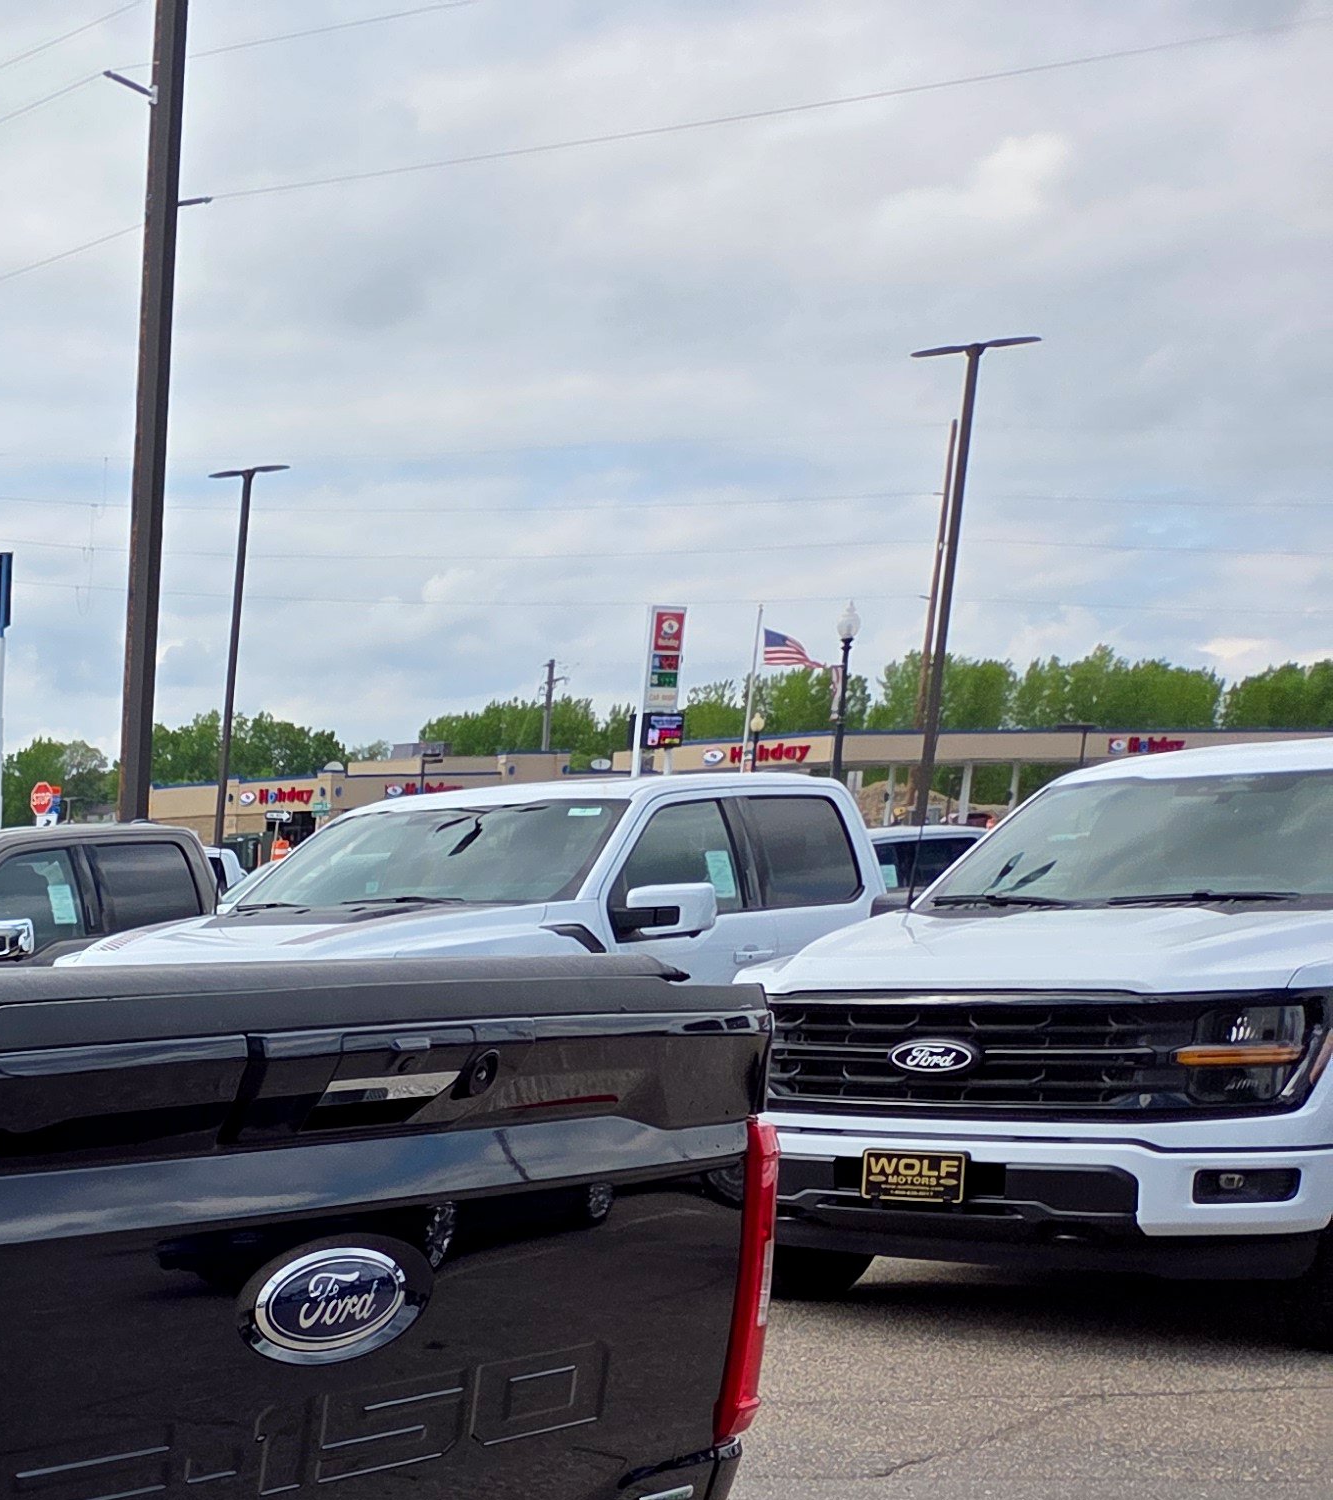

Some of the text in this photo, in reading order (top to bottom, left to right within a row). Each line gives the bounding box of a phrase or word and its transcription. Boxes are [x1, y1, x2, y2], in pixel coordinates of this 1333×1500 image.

[32, 792, 51, 805] STOP
[906, 1046, 956, 1067] Ford
[869, 1157, 959, 1177] WOLF
[888, 1175, 937, 1186] MOTORS
[299, 1271, 377, 1329] Ford
